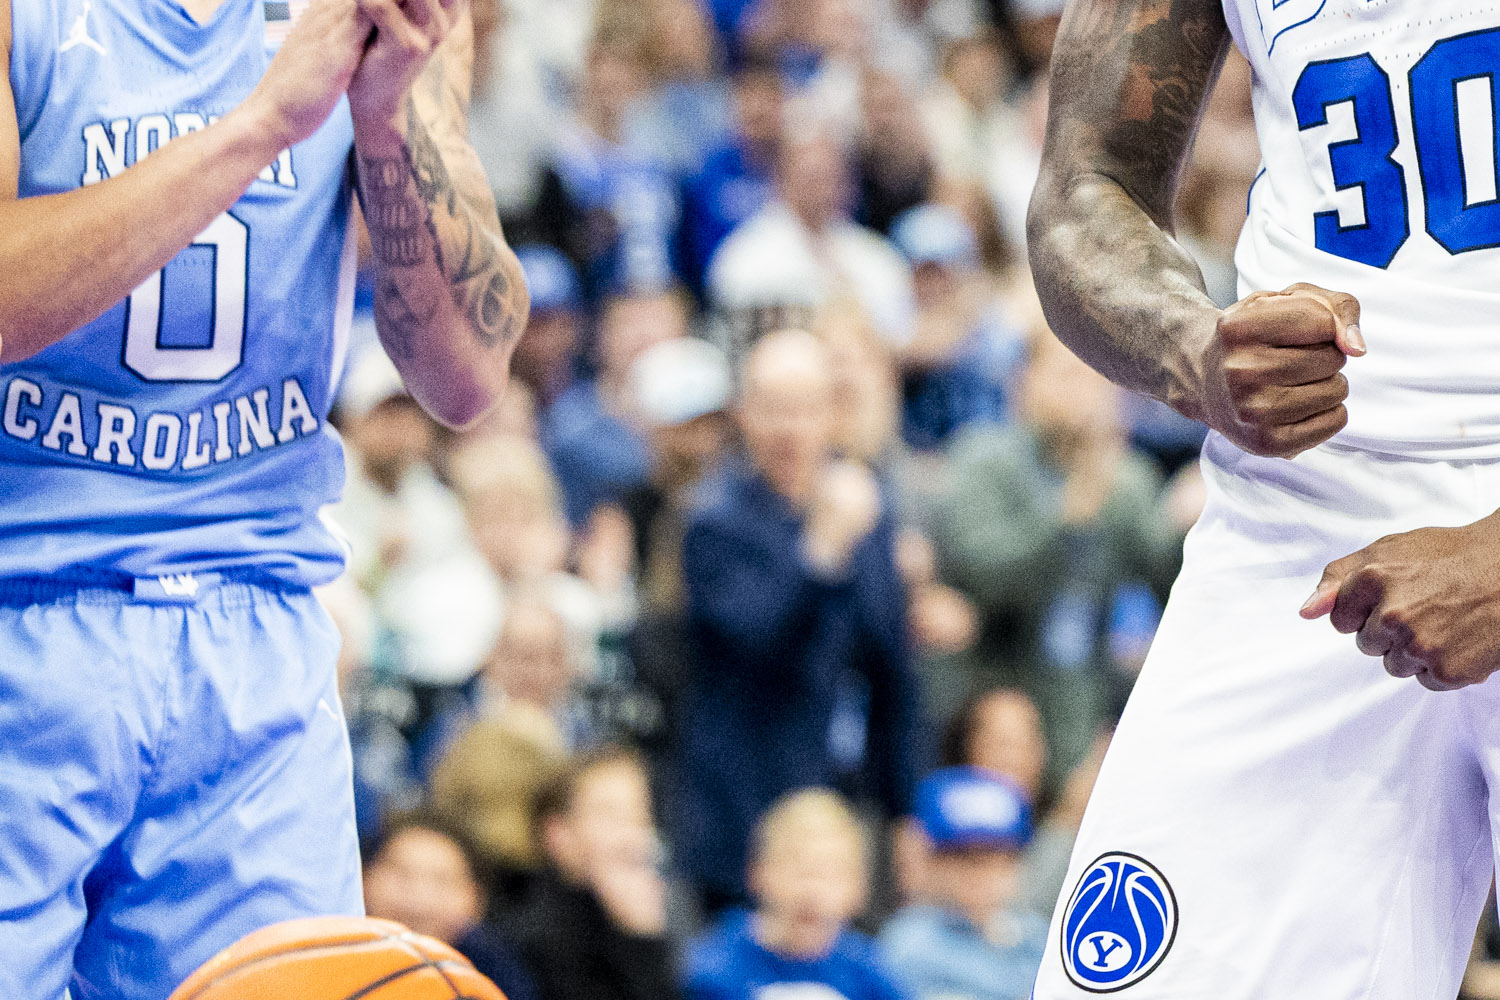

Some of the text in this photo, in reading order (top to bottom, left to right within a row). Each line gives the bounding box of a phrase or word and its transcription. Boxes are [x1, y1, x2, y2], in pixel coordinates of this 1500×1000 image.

[120, 208, 251, 384] 0
[2, 374, 320, 471] CAROLINA
[1088, 935, 1124, 968] Y
